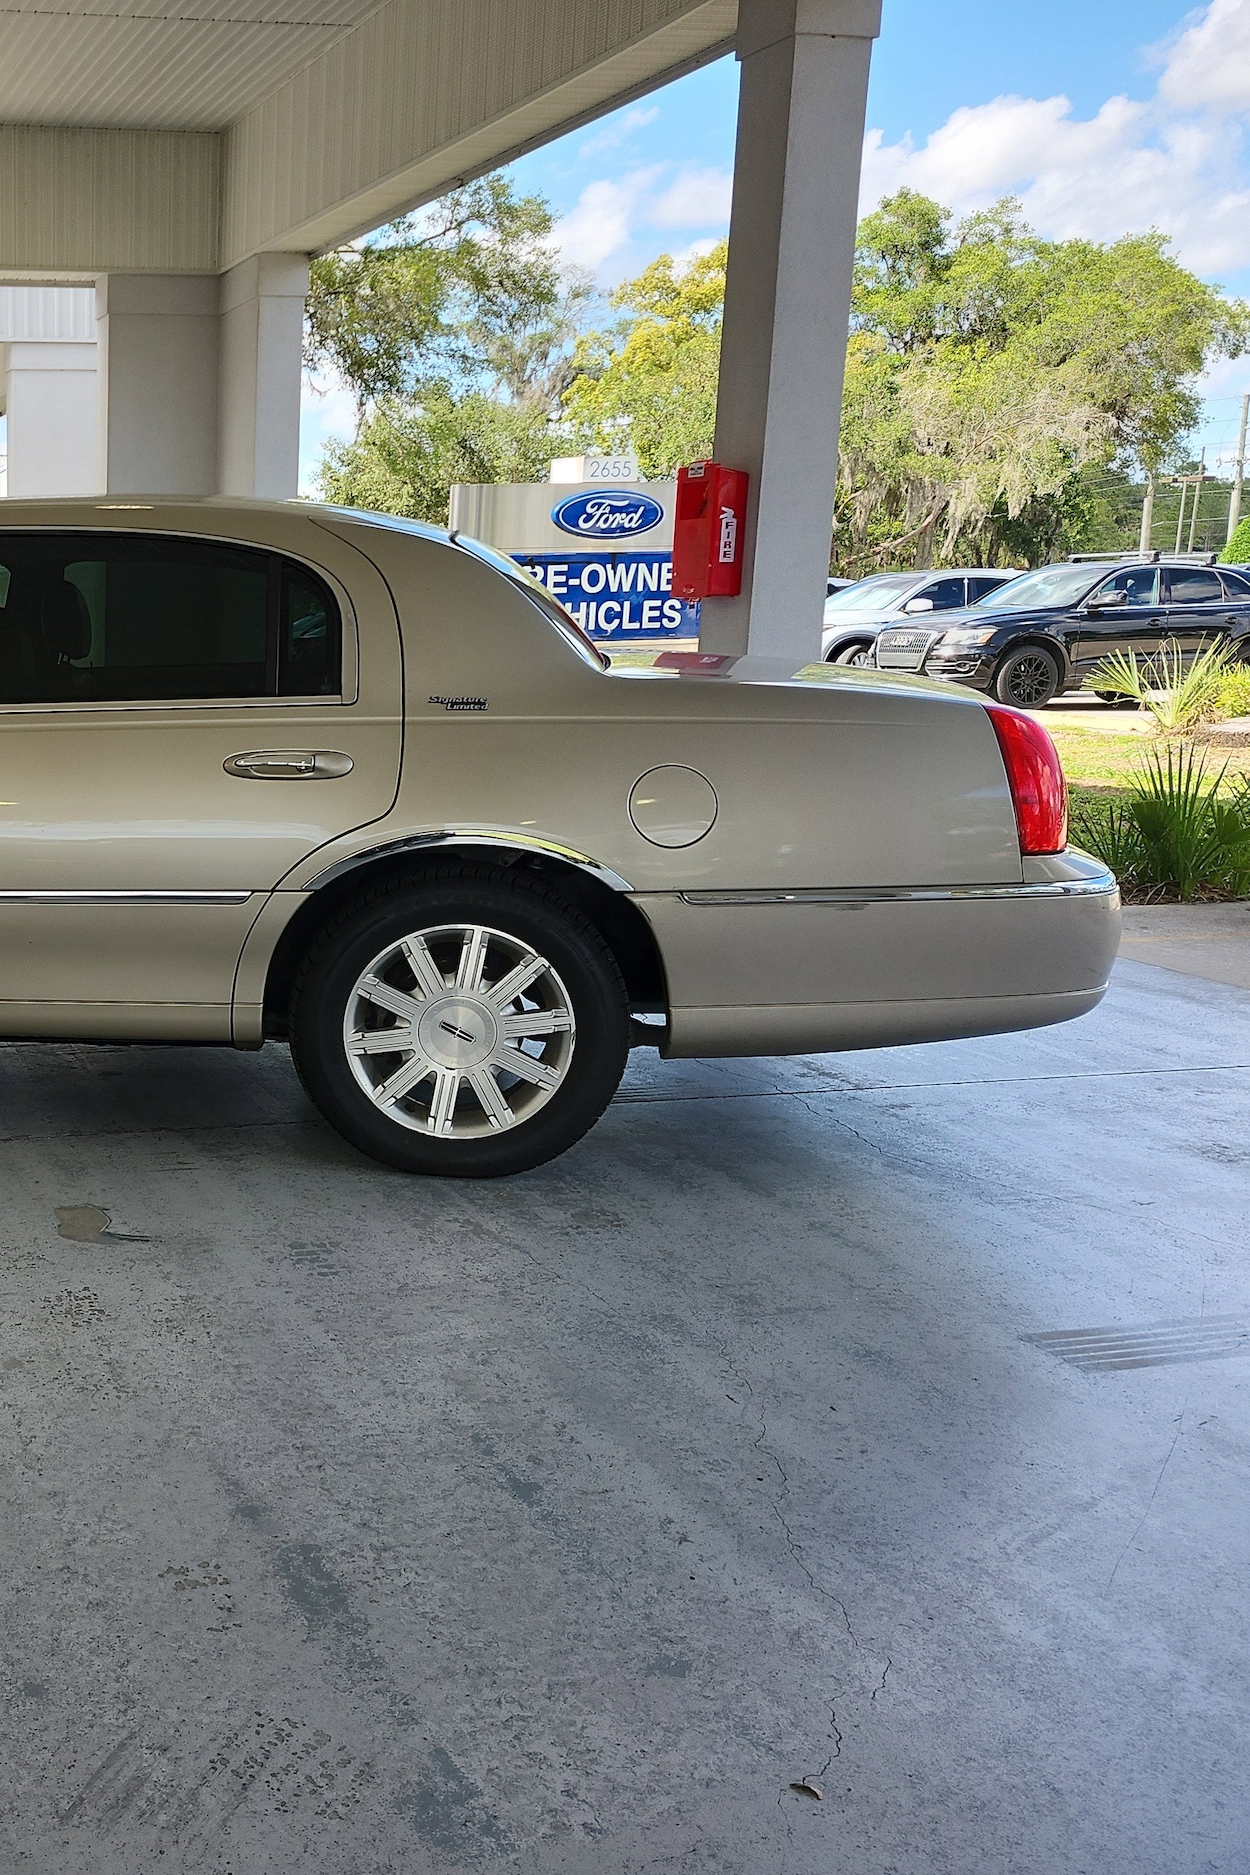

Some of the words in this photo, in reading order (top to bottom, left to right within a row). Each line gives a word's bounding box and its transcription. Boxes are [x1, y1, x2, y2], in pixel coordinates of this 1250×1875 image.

[590, 461, 631, 478] 2655
[578, 499, 645, 529] Ford
[723, 521, 734, 559] FIRE
[564, 598, 682, 630] HICLES
[428, 695, 487, 704] Signature
[446, 702, 489, 711] Limited
